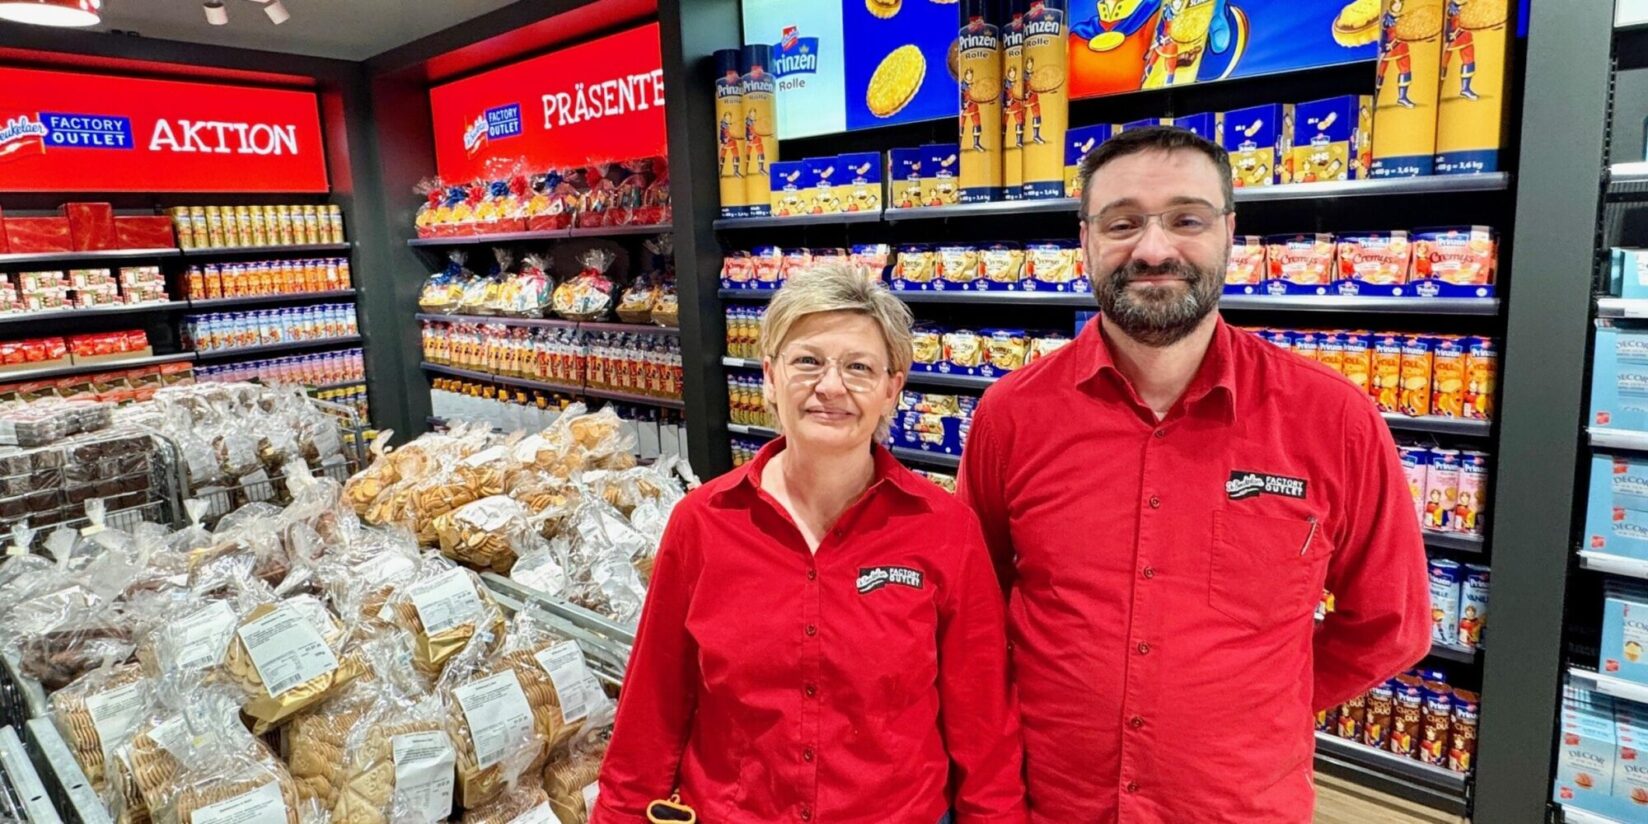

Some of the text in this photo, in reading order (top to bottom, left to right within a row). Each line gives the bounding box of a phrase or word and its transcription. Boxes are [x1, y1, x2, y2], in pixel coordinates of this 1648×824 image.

[960, 34, 996, 51] Prinzen
[1026, 38, 1049, 48] Rolle
[965, 51, 989, 60] Rolle
[774, 54, 816, 75] rinzen
[743, 79, 774, 93] Prinzen
[780, 79, 806, 92] Rolle
[541, 69, 665, 130] PRÄSENTE
[488, 107, 518, 122] FACTORY
[50, 117, 123, 131] FACTORY
[489, 121, 519, 137] OUTLET
[52, 132, 125, 146] OUTLET
[149, 119, 298, 155] AKTION
[1265, 476, 1304, 487] FACTORY
[1265, 484, 1304, 496] OUTLET
[889, 567, 920, 579] FACTORY
[889, 575, 920, 588] OUTLET
[1375, 705, 1391, 715] DUO
[1569, 750, 1605, 765] DECOR
